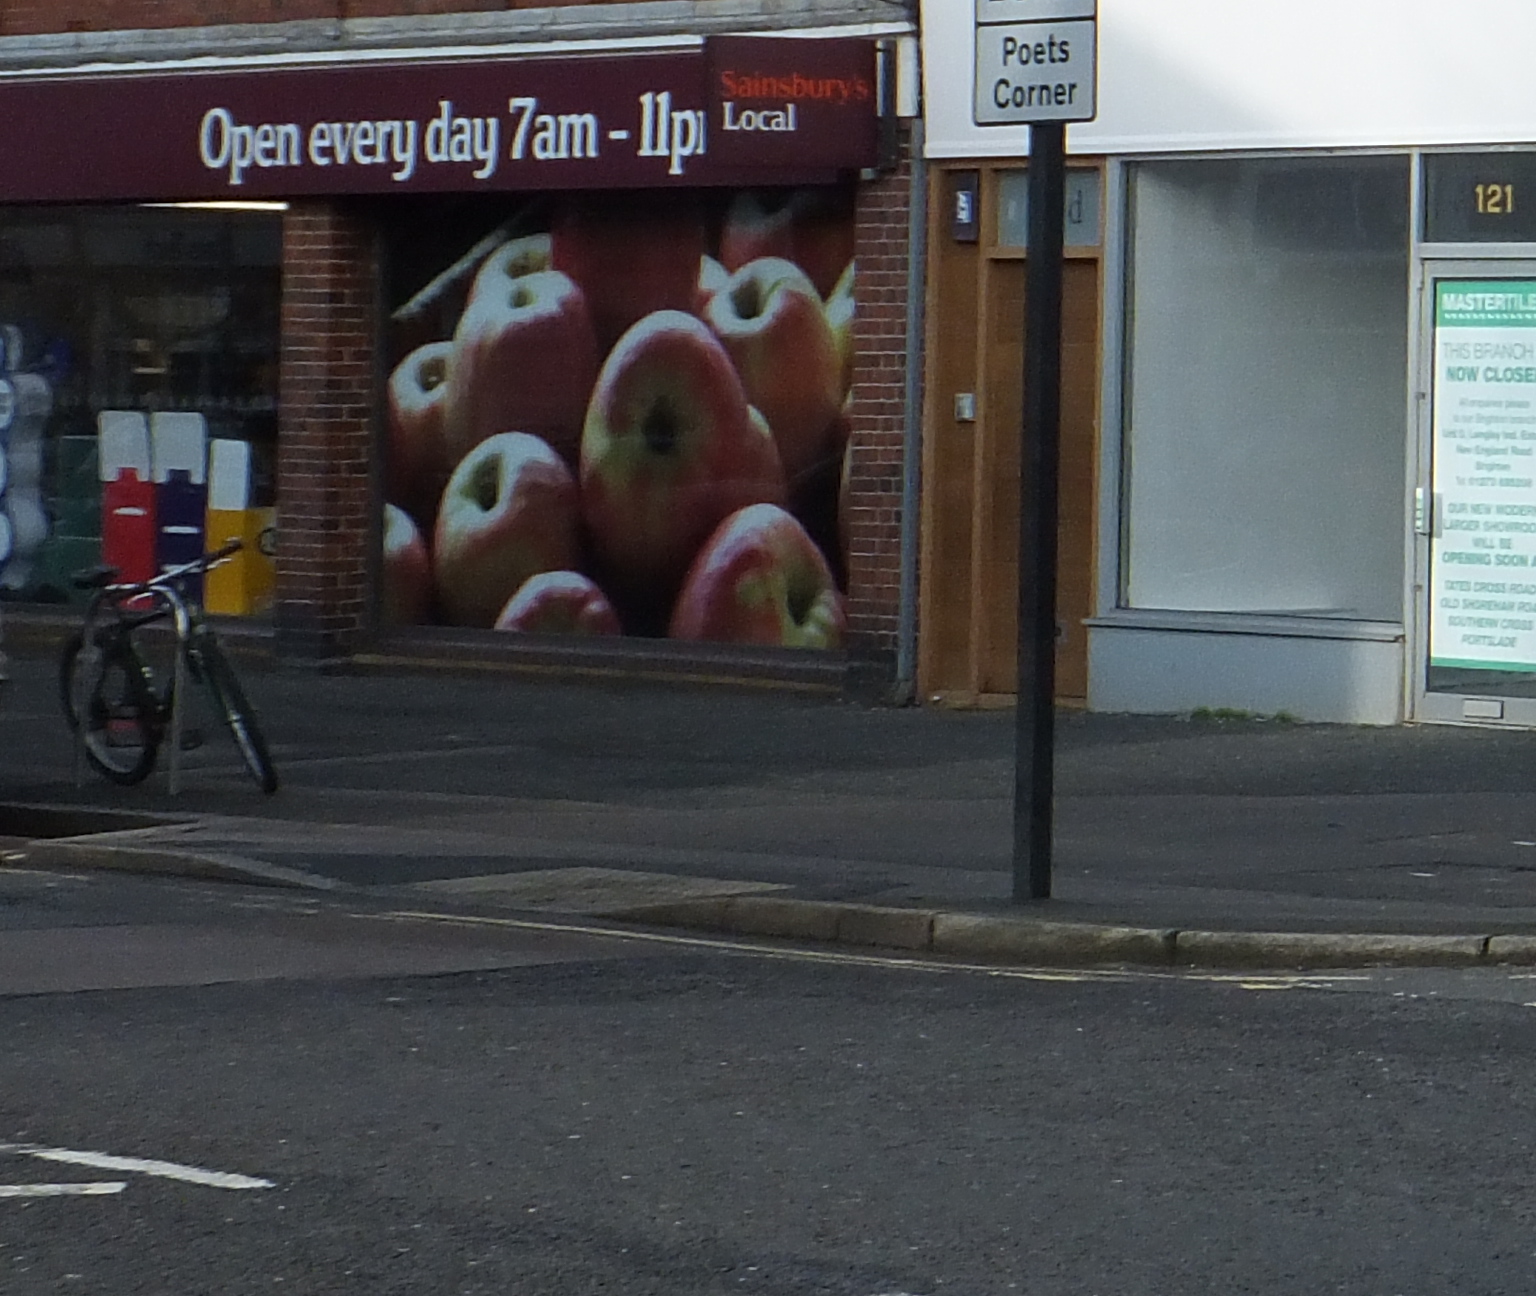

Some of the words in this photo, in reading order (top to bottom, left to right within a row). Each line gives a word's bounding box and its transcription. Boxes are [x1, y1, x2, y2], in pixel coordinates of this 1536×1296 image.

[1003, 34, 1070, 66] Poets
[722, 70, 869, 105] Sainsbury's
[994, 77, 1077, 108] Corner
[723, 102, 797, 131] Local
[200, 106, 302, 185] Open
[309, 115, 416, 182] every
[427, 102, 499, 180] day
[508, 96, 599, 160] 7am
[637, 90, 707, 176] 11p
[1475, 184, 1513, 213] 121
[1443, 342, 1471, 360] THIS
[1474, 342, 1534, 360] BRANCH
[1446, 366, 1479, 382] NOW
[1442, 551, 1492, 565] OPENING
[1495, 553, 1529, 567] SOON
